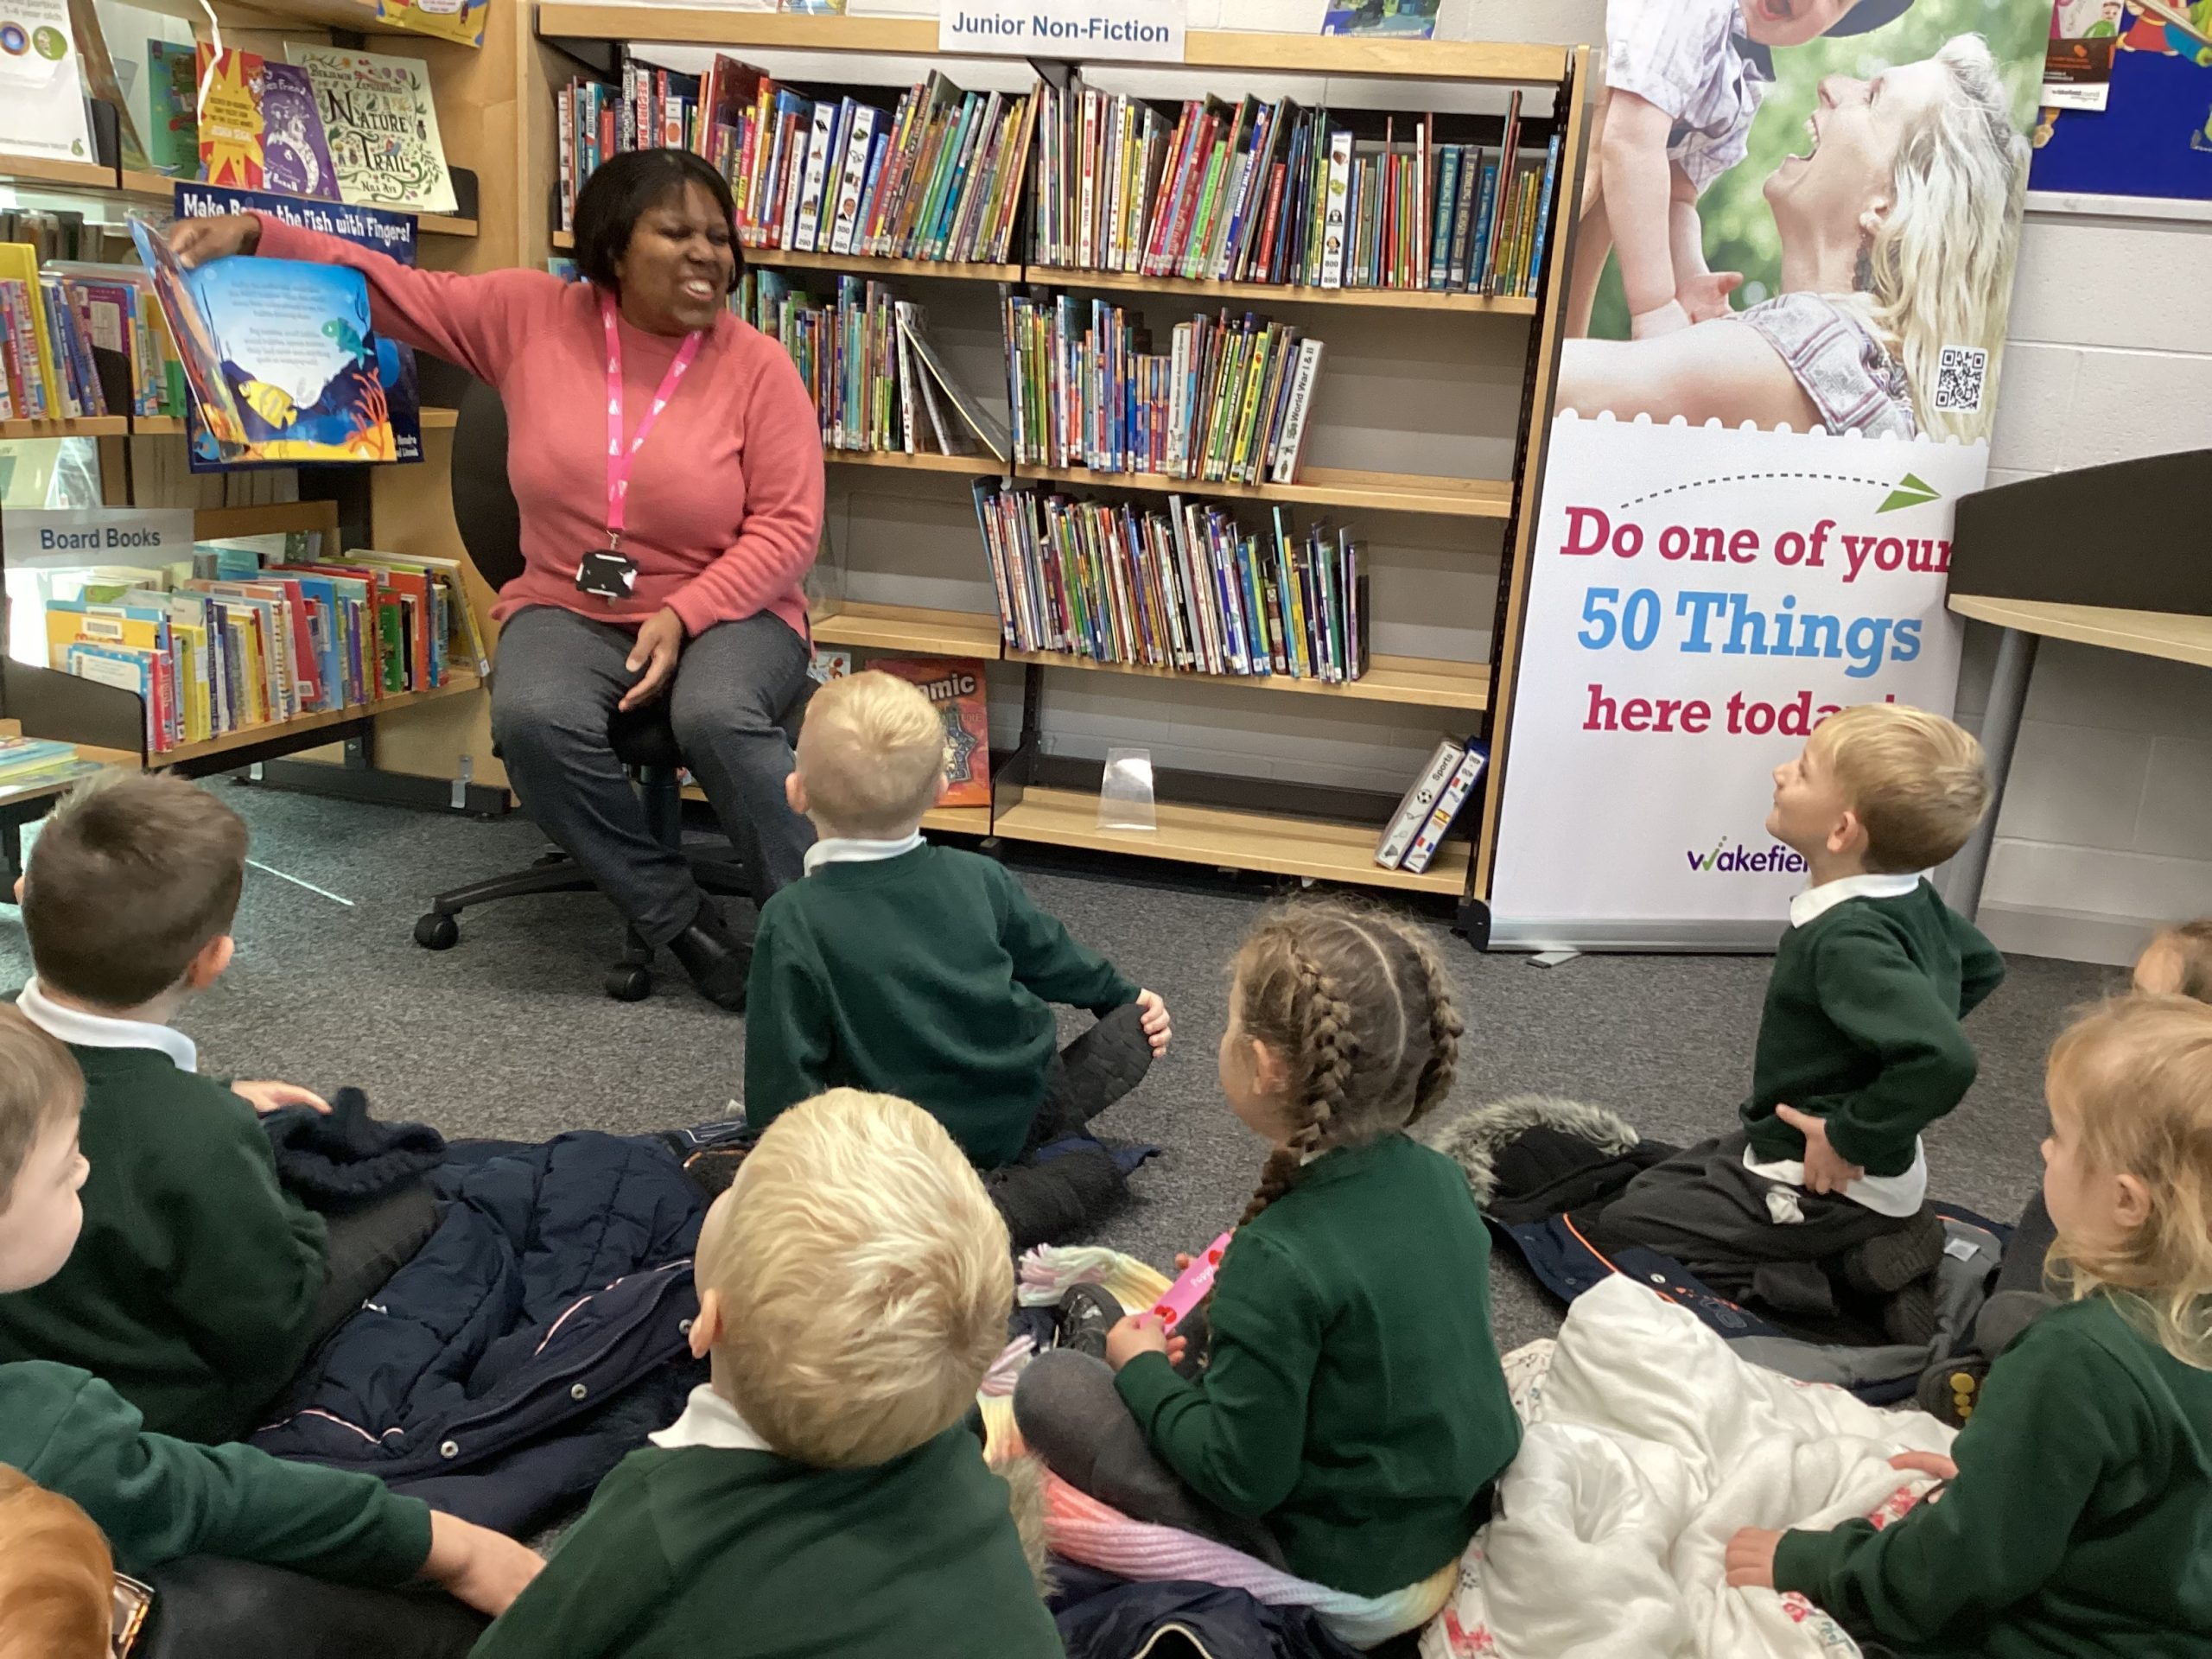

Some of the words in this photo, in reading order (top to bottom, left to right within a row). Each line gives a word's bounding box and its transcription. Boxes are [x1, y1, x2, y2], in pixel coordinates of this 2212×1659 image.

[951, 12, 1026, 36] Junior
[1032, 16, 1169, 42] Non-Fiction
[321, 88, 410, 133] NATURE
[346, 130, 412, 173] TRAIL
[1246, 149, 1255, 170] MEET
[1241, 170, 1251, 186] THE
[1234, 187, 1246, 218] ENGINES
[183, 193, 226, 217] Make
[276, 204, 302, 227] the
[302, 209, 334, 232] Fish
[335, 213, 365, 236] with
[366, 217, 410, 247] Fingers!
[1324, 276, 1338, 285] 890
[1230, 375, 1241, 404] AFRICAN
[1290, 392, 1303, 422] World
[1298, 372, 1308, 391] War
[1304, 355, 1313, 364] &
[41, 529, 100, 550] Board
[106, 528, 161, 548] Books
[1560, 506, 1643, 558] Do
[1658, 525, 1759, 563] one
[1774, 519, 1837, 568] of
[1840, 535, 1953, 583] your
[1577, 588, 1661, 651] 50
[1675, 591, 1923, 678] Things
[1582, 683, 1712, 734] here
[1432, 753, 1453, 780] Sports
